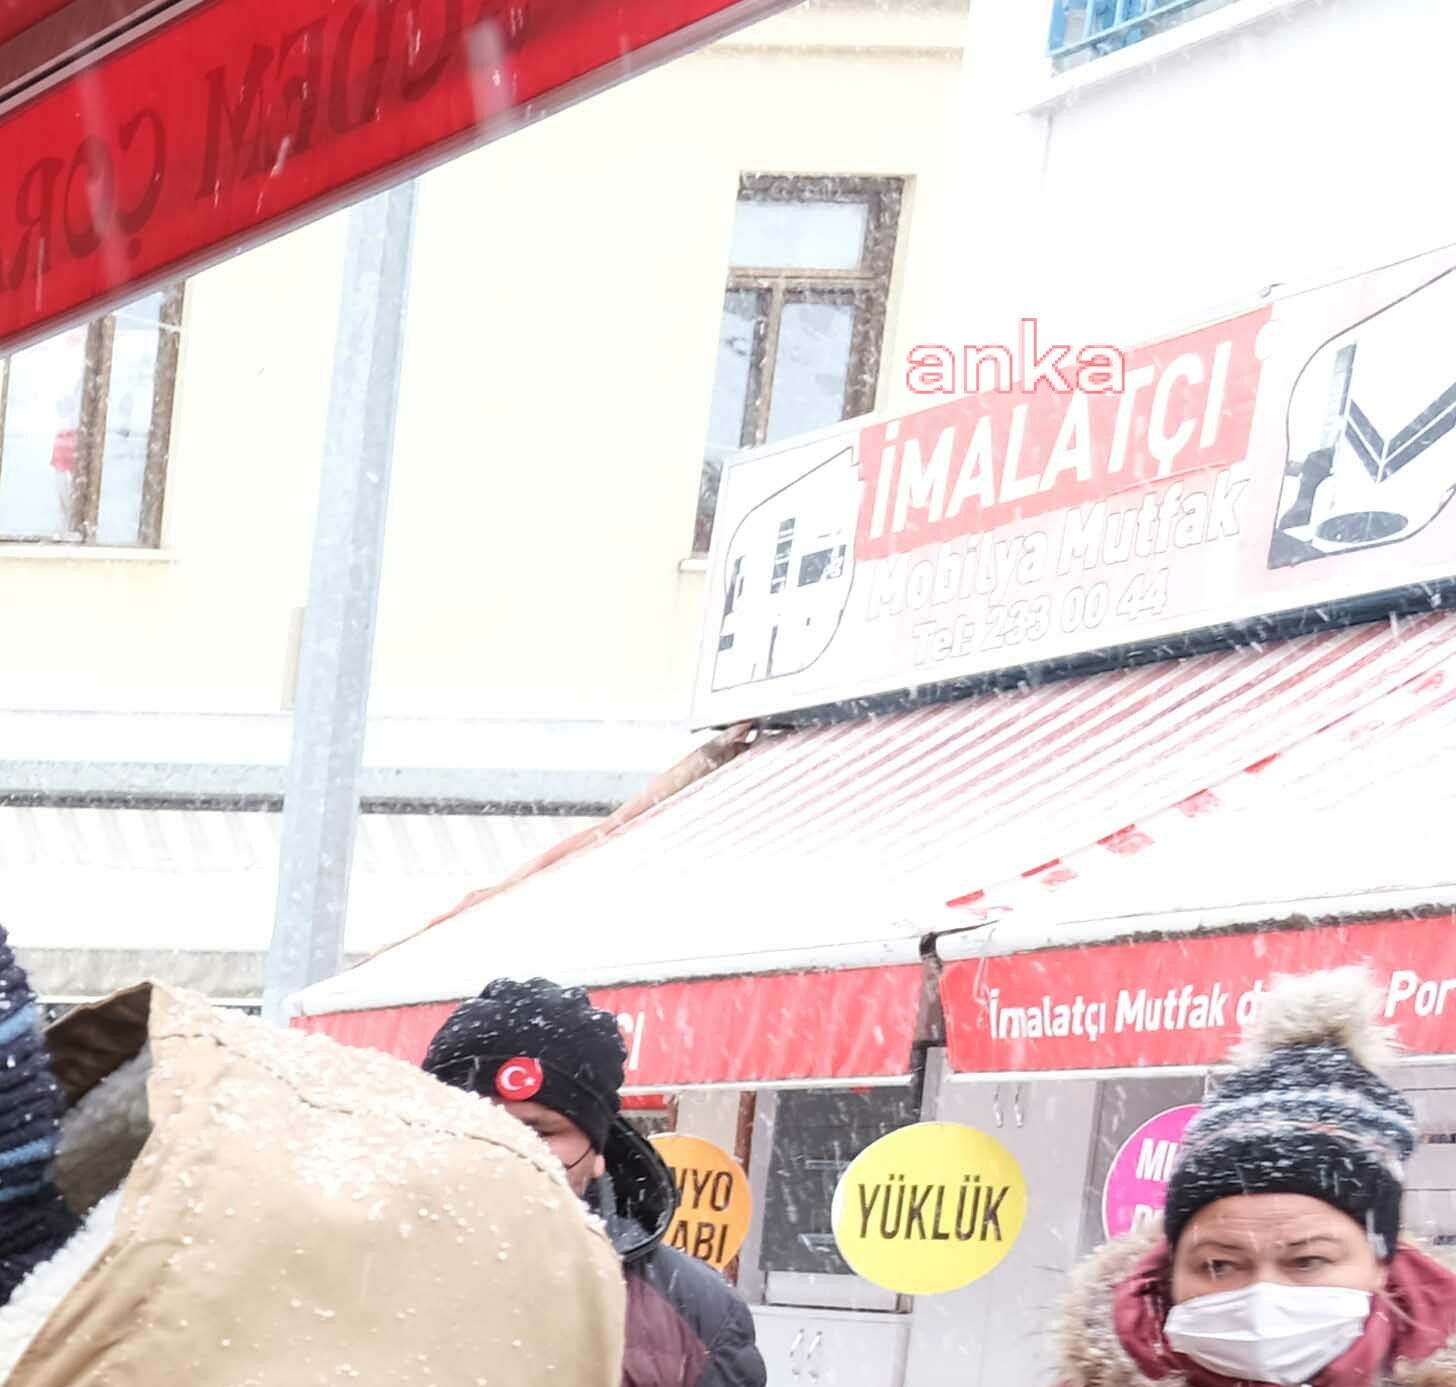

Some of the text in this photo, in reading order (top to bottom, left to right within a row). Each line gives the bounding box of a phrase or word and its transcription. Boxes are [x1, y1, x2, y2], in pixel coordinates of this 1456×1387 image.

[870, 342, 1232, 540] İMALATÇI
[865, 476, 1250, 622] Mobilya Mutfak
[979, 595, 1050, 655] 233
[1061, 580, 1110, 634] 00
[1116, 567, 1170, 620] 44
[989, 988, 1106, 1042] İmalatçı
[1114, 978, 1229, 1033] Mutfak
[669, 1219, 730, 1265] ABI
[857, 1173, 1011, 1242] YÜKLÜK
